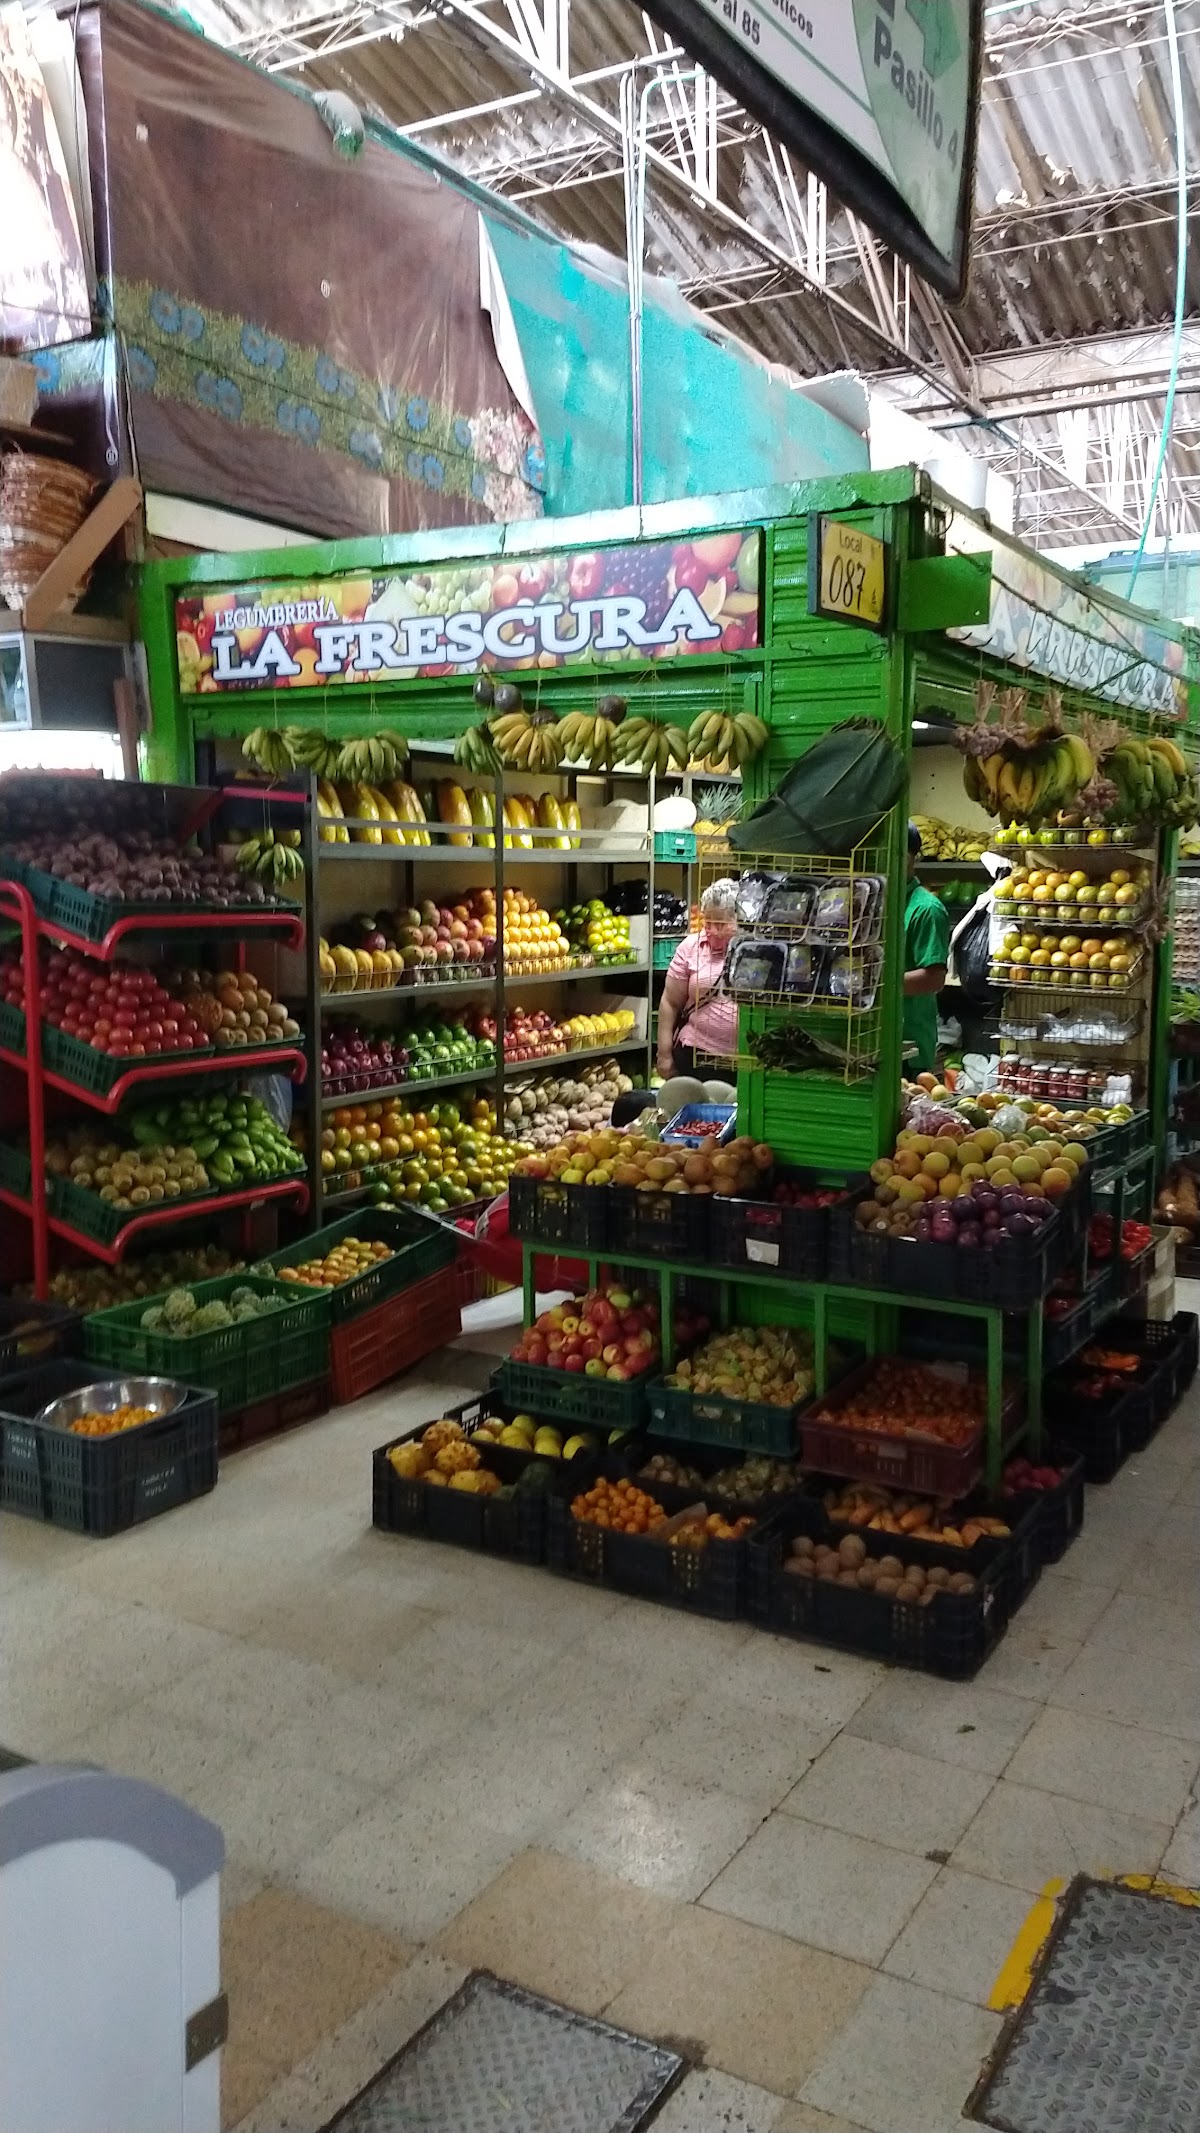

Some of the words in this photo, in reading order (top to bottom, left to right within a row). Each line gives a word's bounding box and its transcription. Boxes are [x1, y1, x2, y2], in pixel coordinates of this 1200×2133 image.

[742, 10, 760, 45] 85
[873, 15, 943, 149] Pasillo
[948, 128, 959, 173] 4
[839, 528, 862, 553] Local
[829, 555, 865, 612] 087
[211, 630, 301, 680] LA
[314, 588, 720, 674] FRESCURA
[213, 596, 339, 633] LEGUMBRERÍA
